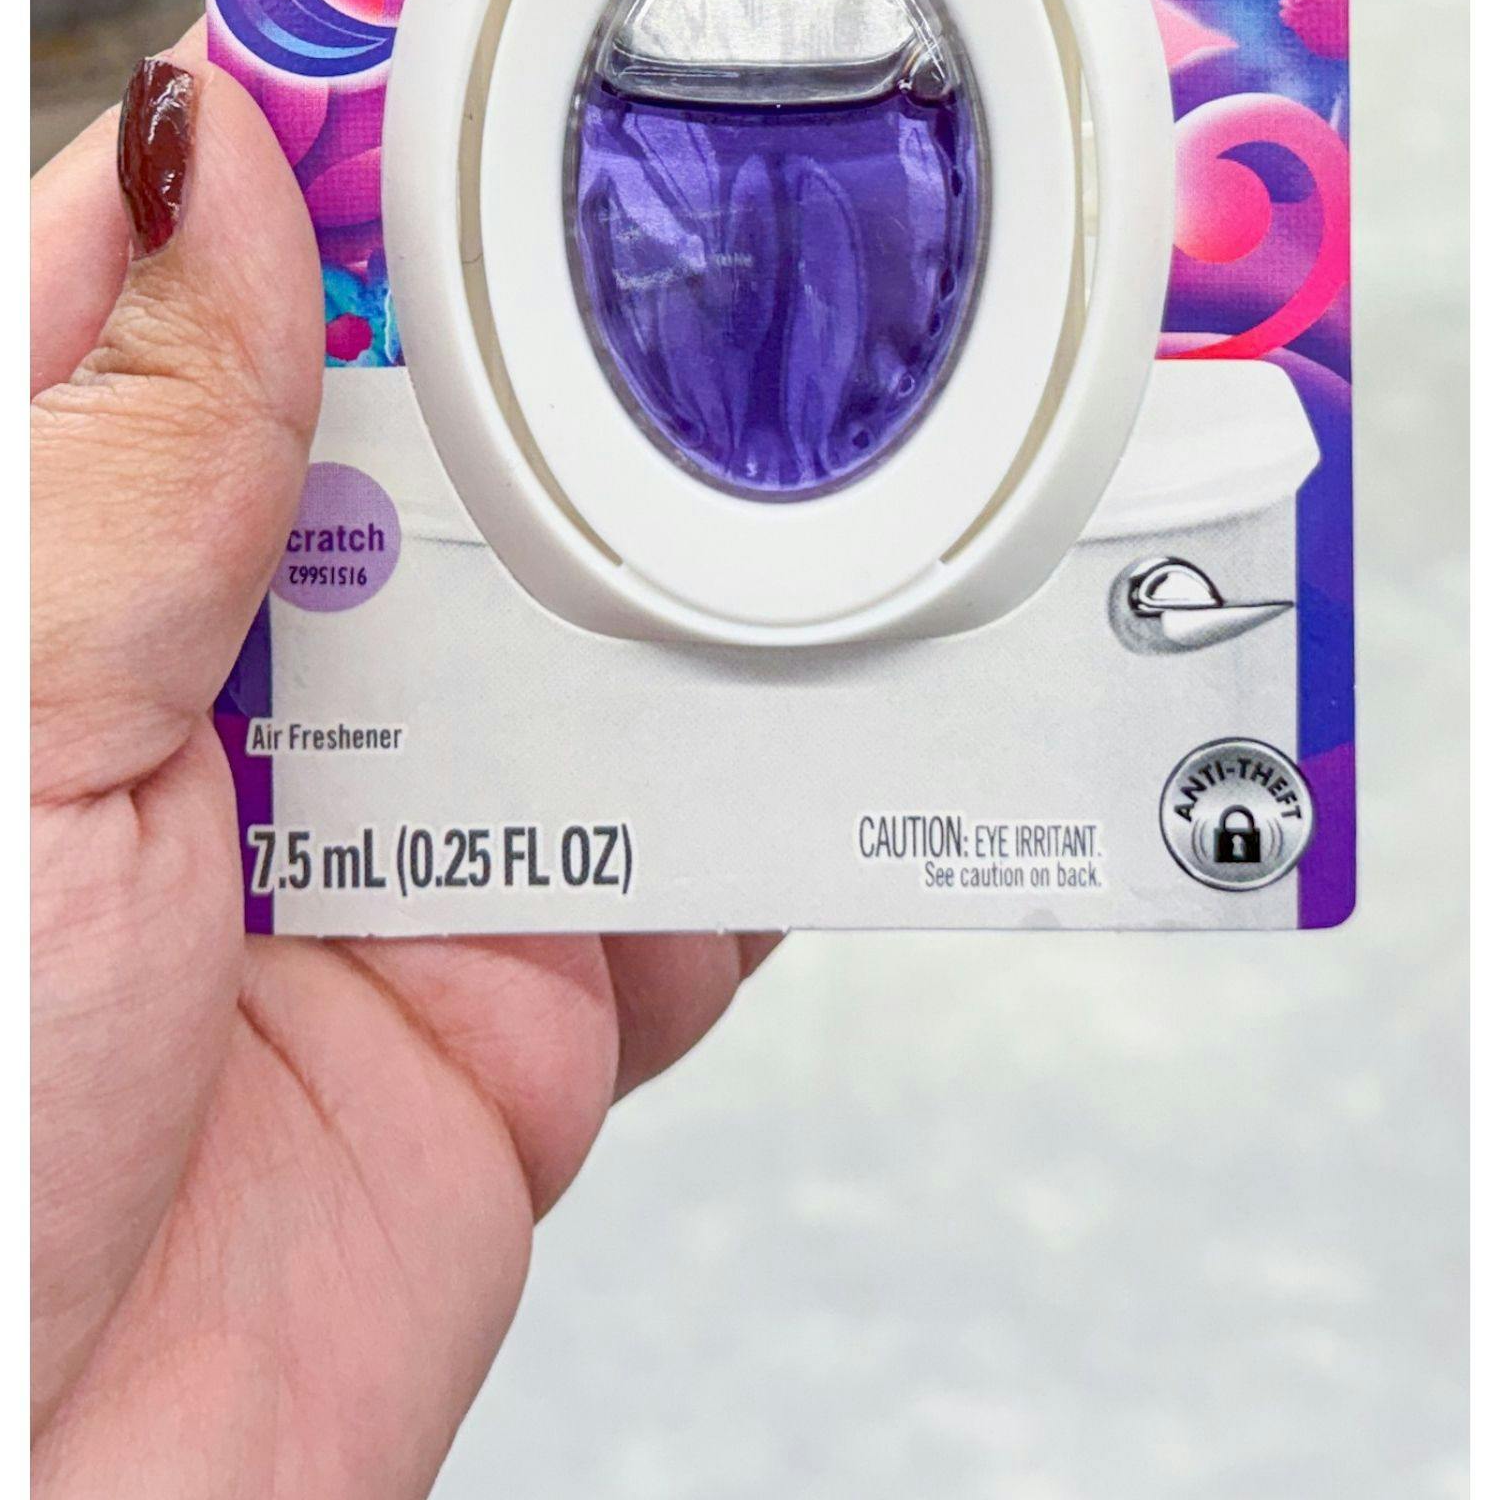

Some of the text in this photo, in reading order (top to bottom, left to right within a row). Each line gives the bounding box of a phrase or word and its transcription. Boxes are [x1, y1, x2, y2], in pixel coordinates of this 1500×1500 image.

[252, 724, 402, 751] Air Freshener
[1173, 758, 1302, 823] ANTI-THEFT
[859, 815, 1102, 859] CAUTION: EYE IRRITANT.
[250, 823, 633, 897] 7.5 mL (0.25 FL OZ)
[925, 861, 1102, 887] See caution on back.
